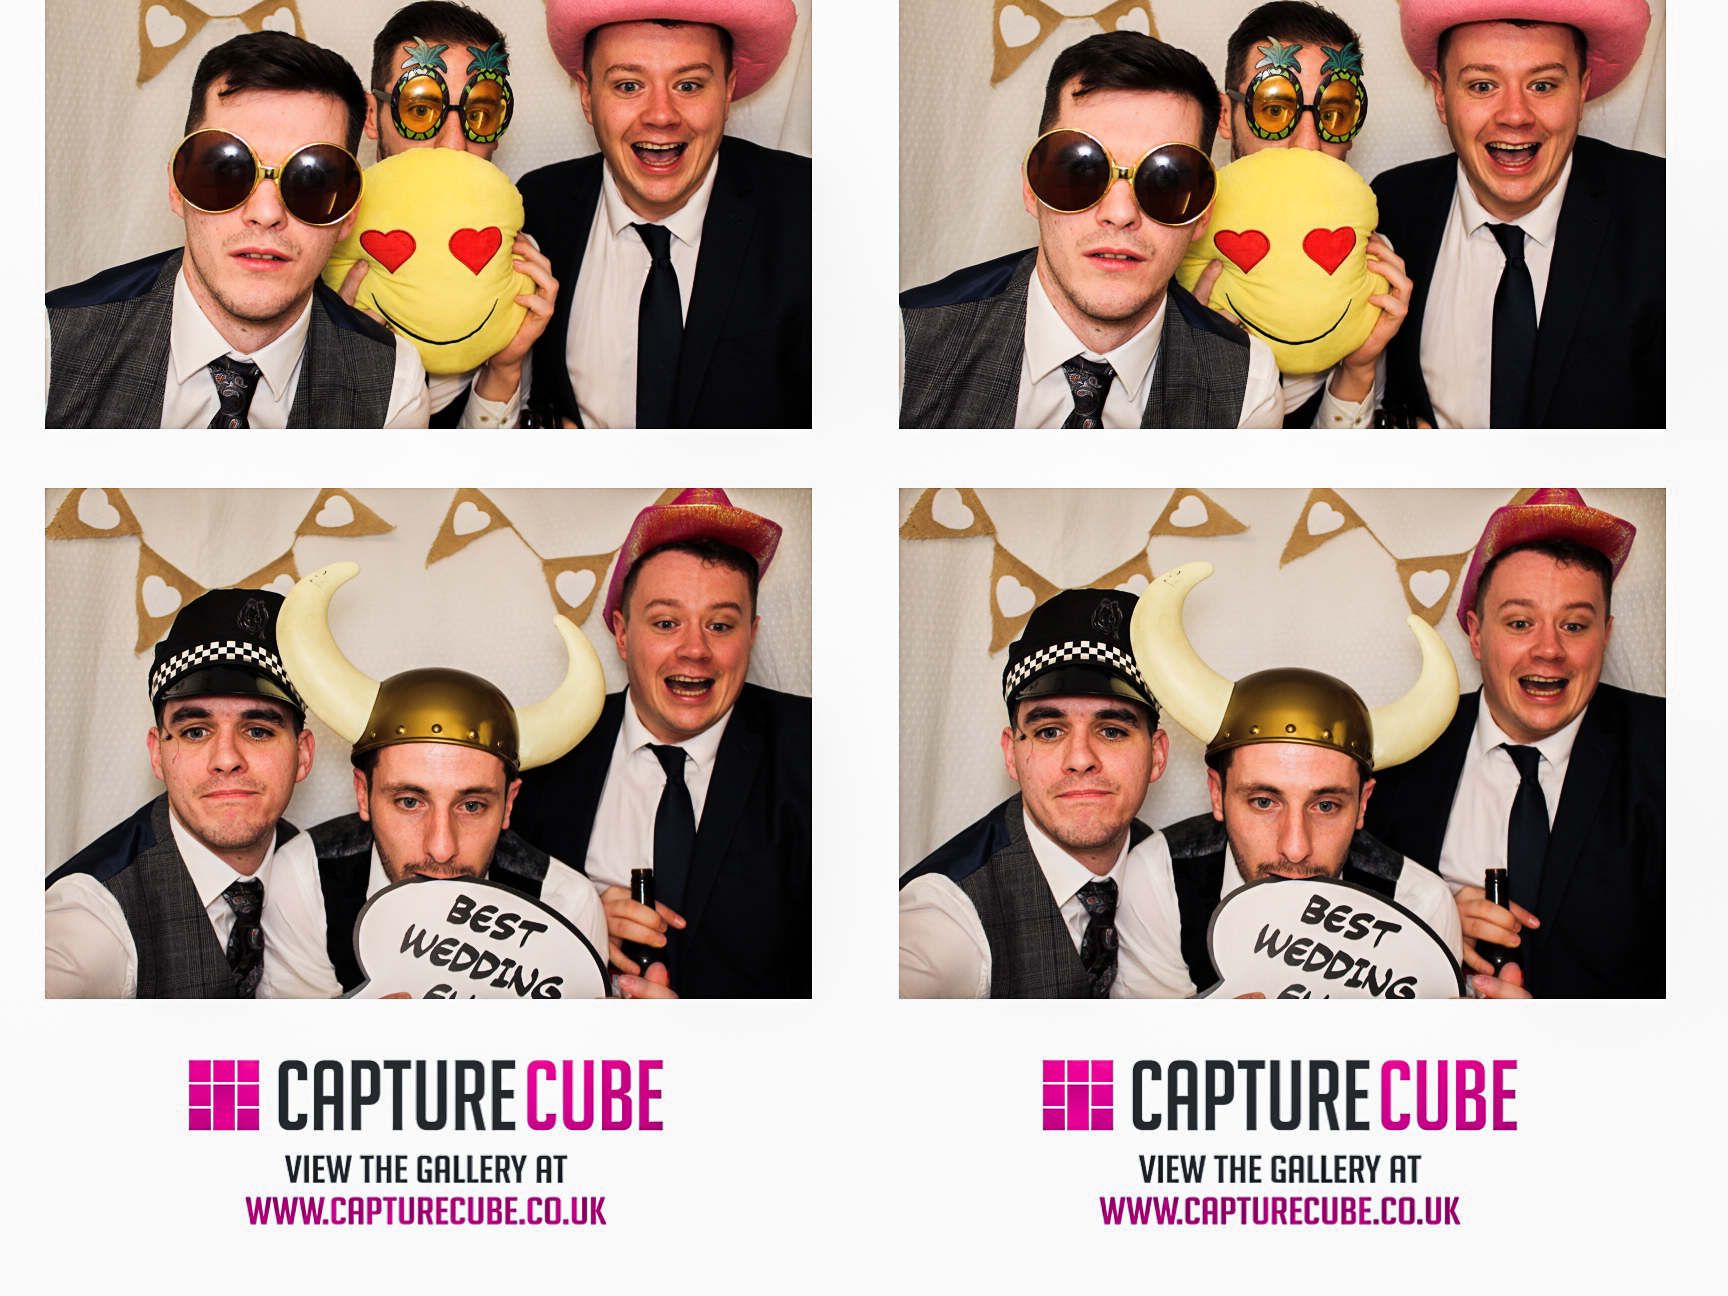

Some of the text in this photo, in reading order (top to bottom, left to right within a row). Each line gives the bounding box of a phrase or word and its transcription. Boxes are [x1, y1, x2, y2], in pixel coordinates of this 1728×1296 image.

[446, 894, 548, 948] BEST
[1300, 894, 1402, 948] BEST
[400, 923, 563, 999] WEDDING
[1254, 923, 1417, 999] WEDDING
